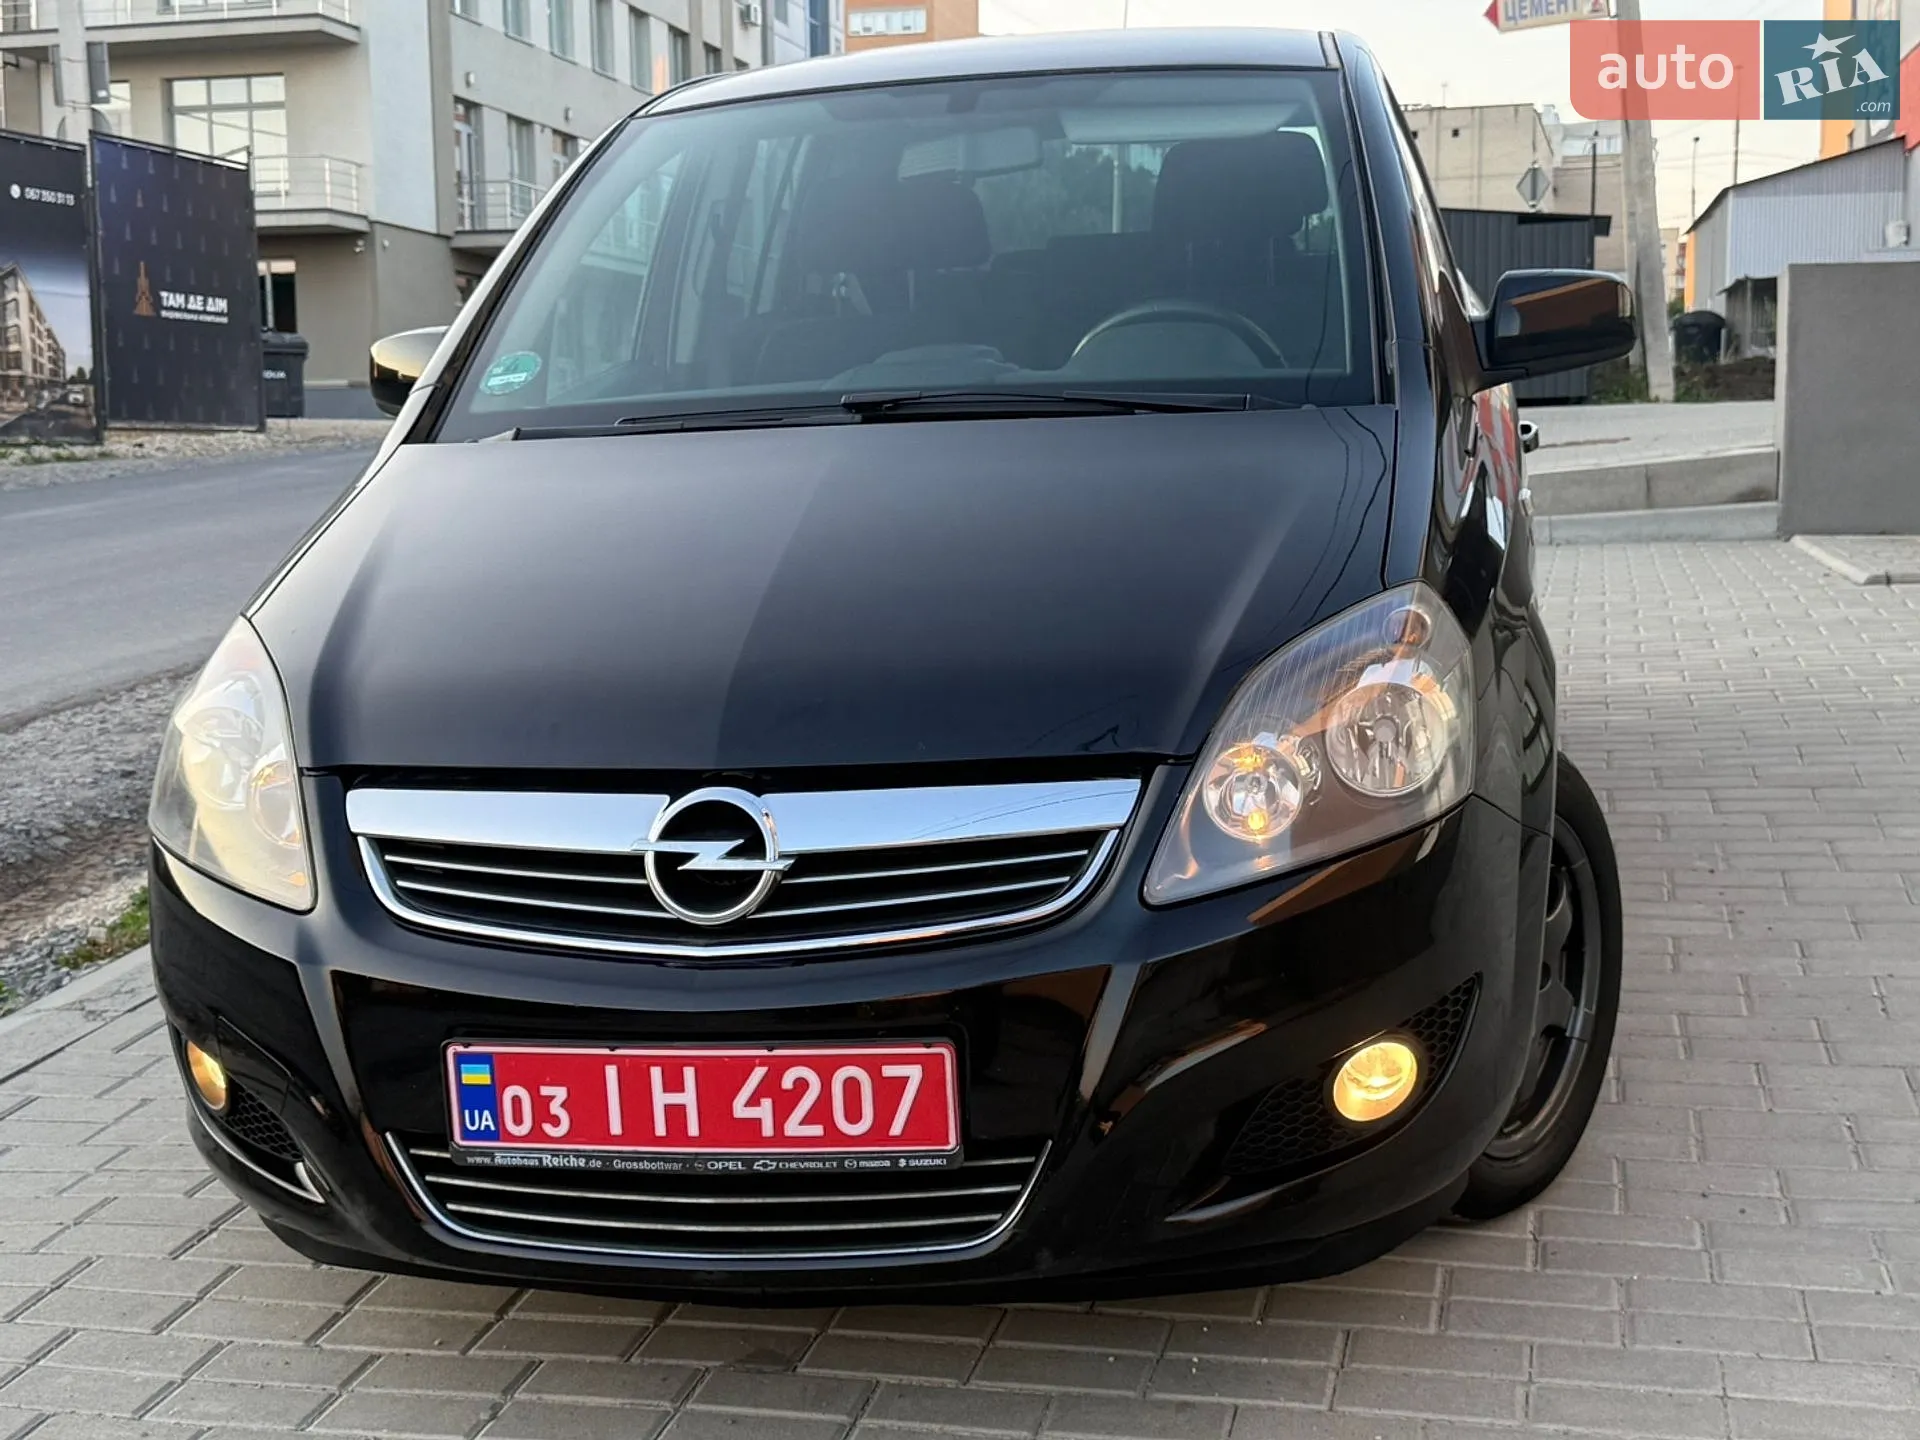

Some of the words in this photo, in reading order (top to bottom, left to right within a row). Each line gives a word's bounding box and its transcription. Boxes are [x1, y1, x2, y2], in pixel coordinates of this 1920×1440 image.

[159, 290, 186, 309] ТАМ
[502, 1085, 570, 1137] 03
[732, 1064, 923, 1137] 4207
[464, 1109, 496, 1131] UA
[707, 1161, 746, 1170] OPEL
[779, 1161, 837, 1169] CHEVROLET
[908, 1158, 946, 1166] SUZUKI
